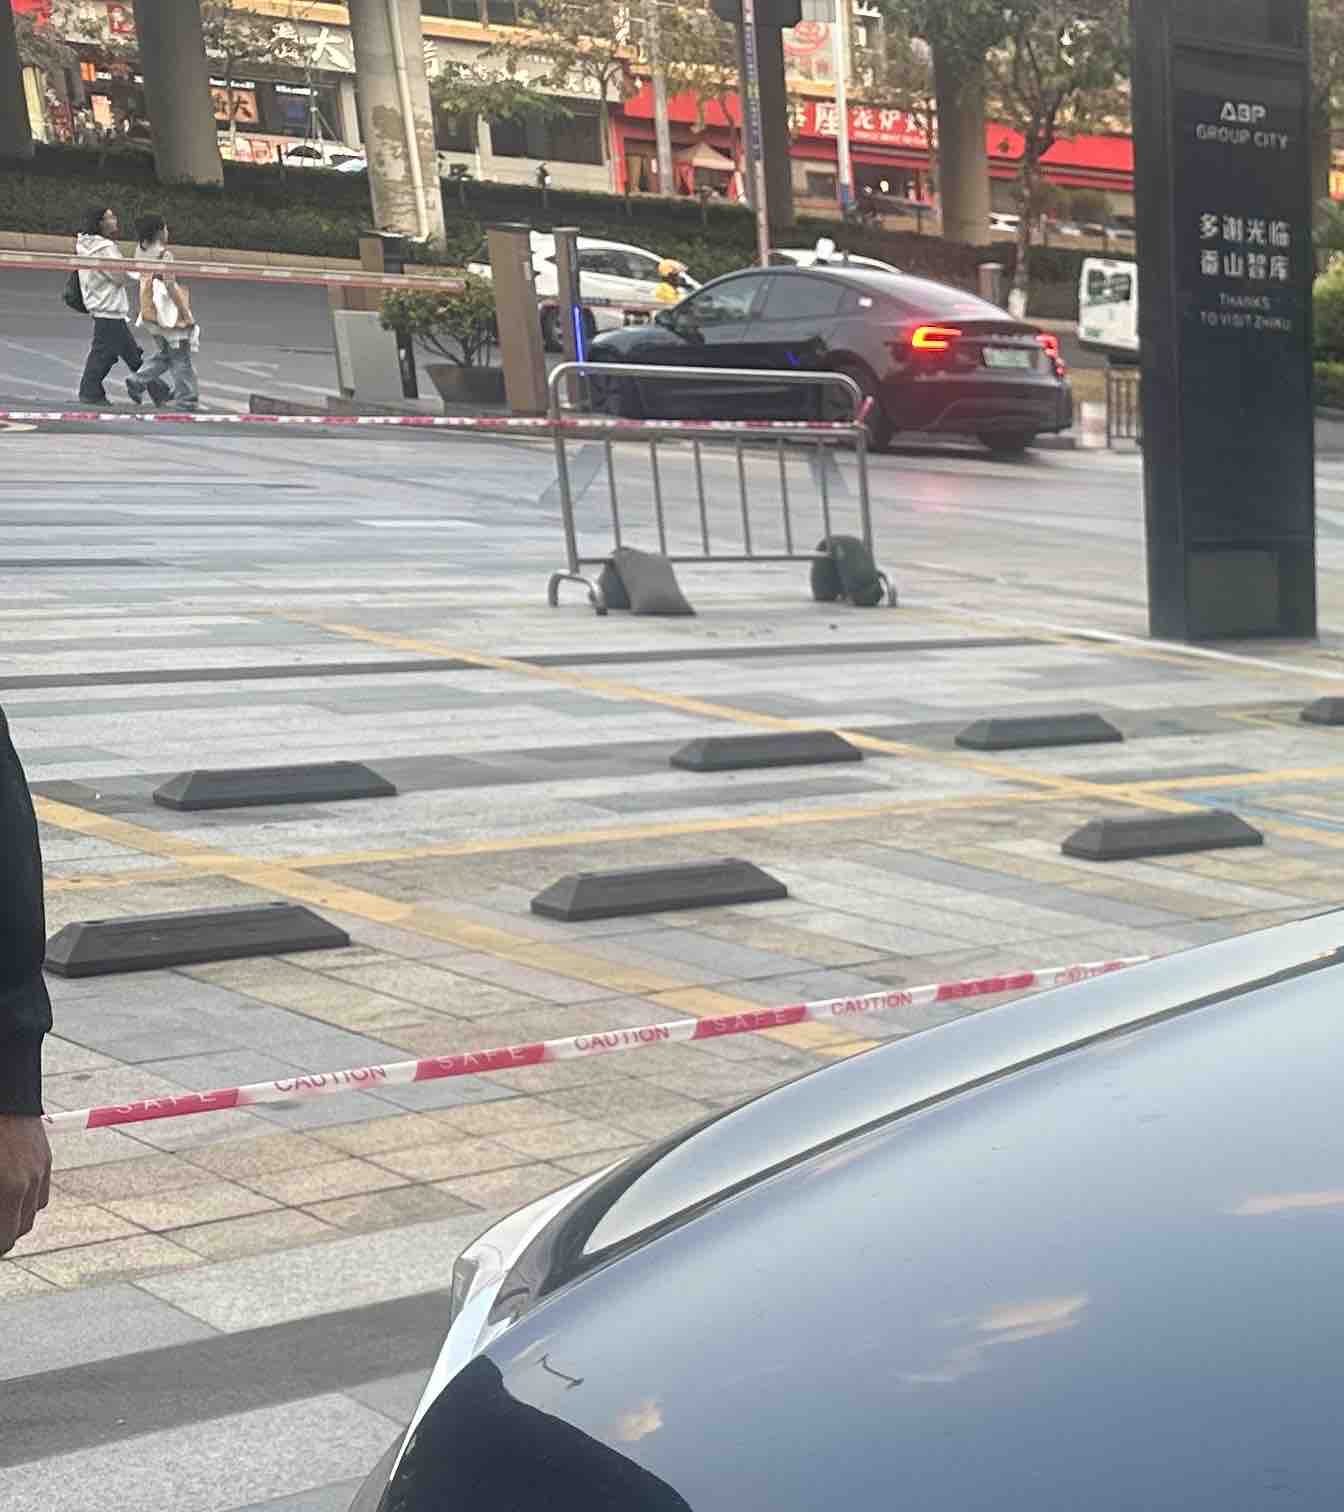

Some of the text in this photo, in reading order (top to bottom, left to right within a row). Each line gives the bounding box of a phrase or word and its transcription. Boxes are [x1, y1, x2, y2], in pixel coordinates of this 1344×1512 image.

[1220, 101, 1266, 123] ABP
[1196, 122, 1288, 150] GROUP CITY
[1199, 212, 1290, 248] 多谢光临
[1219, 292, 1271, 311] THANKS
[1200, 311, 1219, 327] TO
[1220, 312, 1252, 330] VISIT
[273, 1063, 388, 1093] CAUTION
[573, 1025, 671, 1052] CAUTION
[713, 1009, 788, 1033] SAFE
[831, 991, 913, 1016] CAUTION
